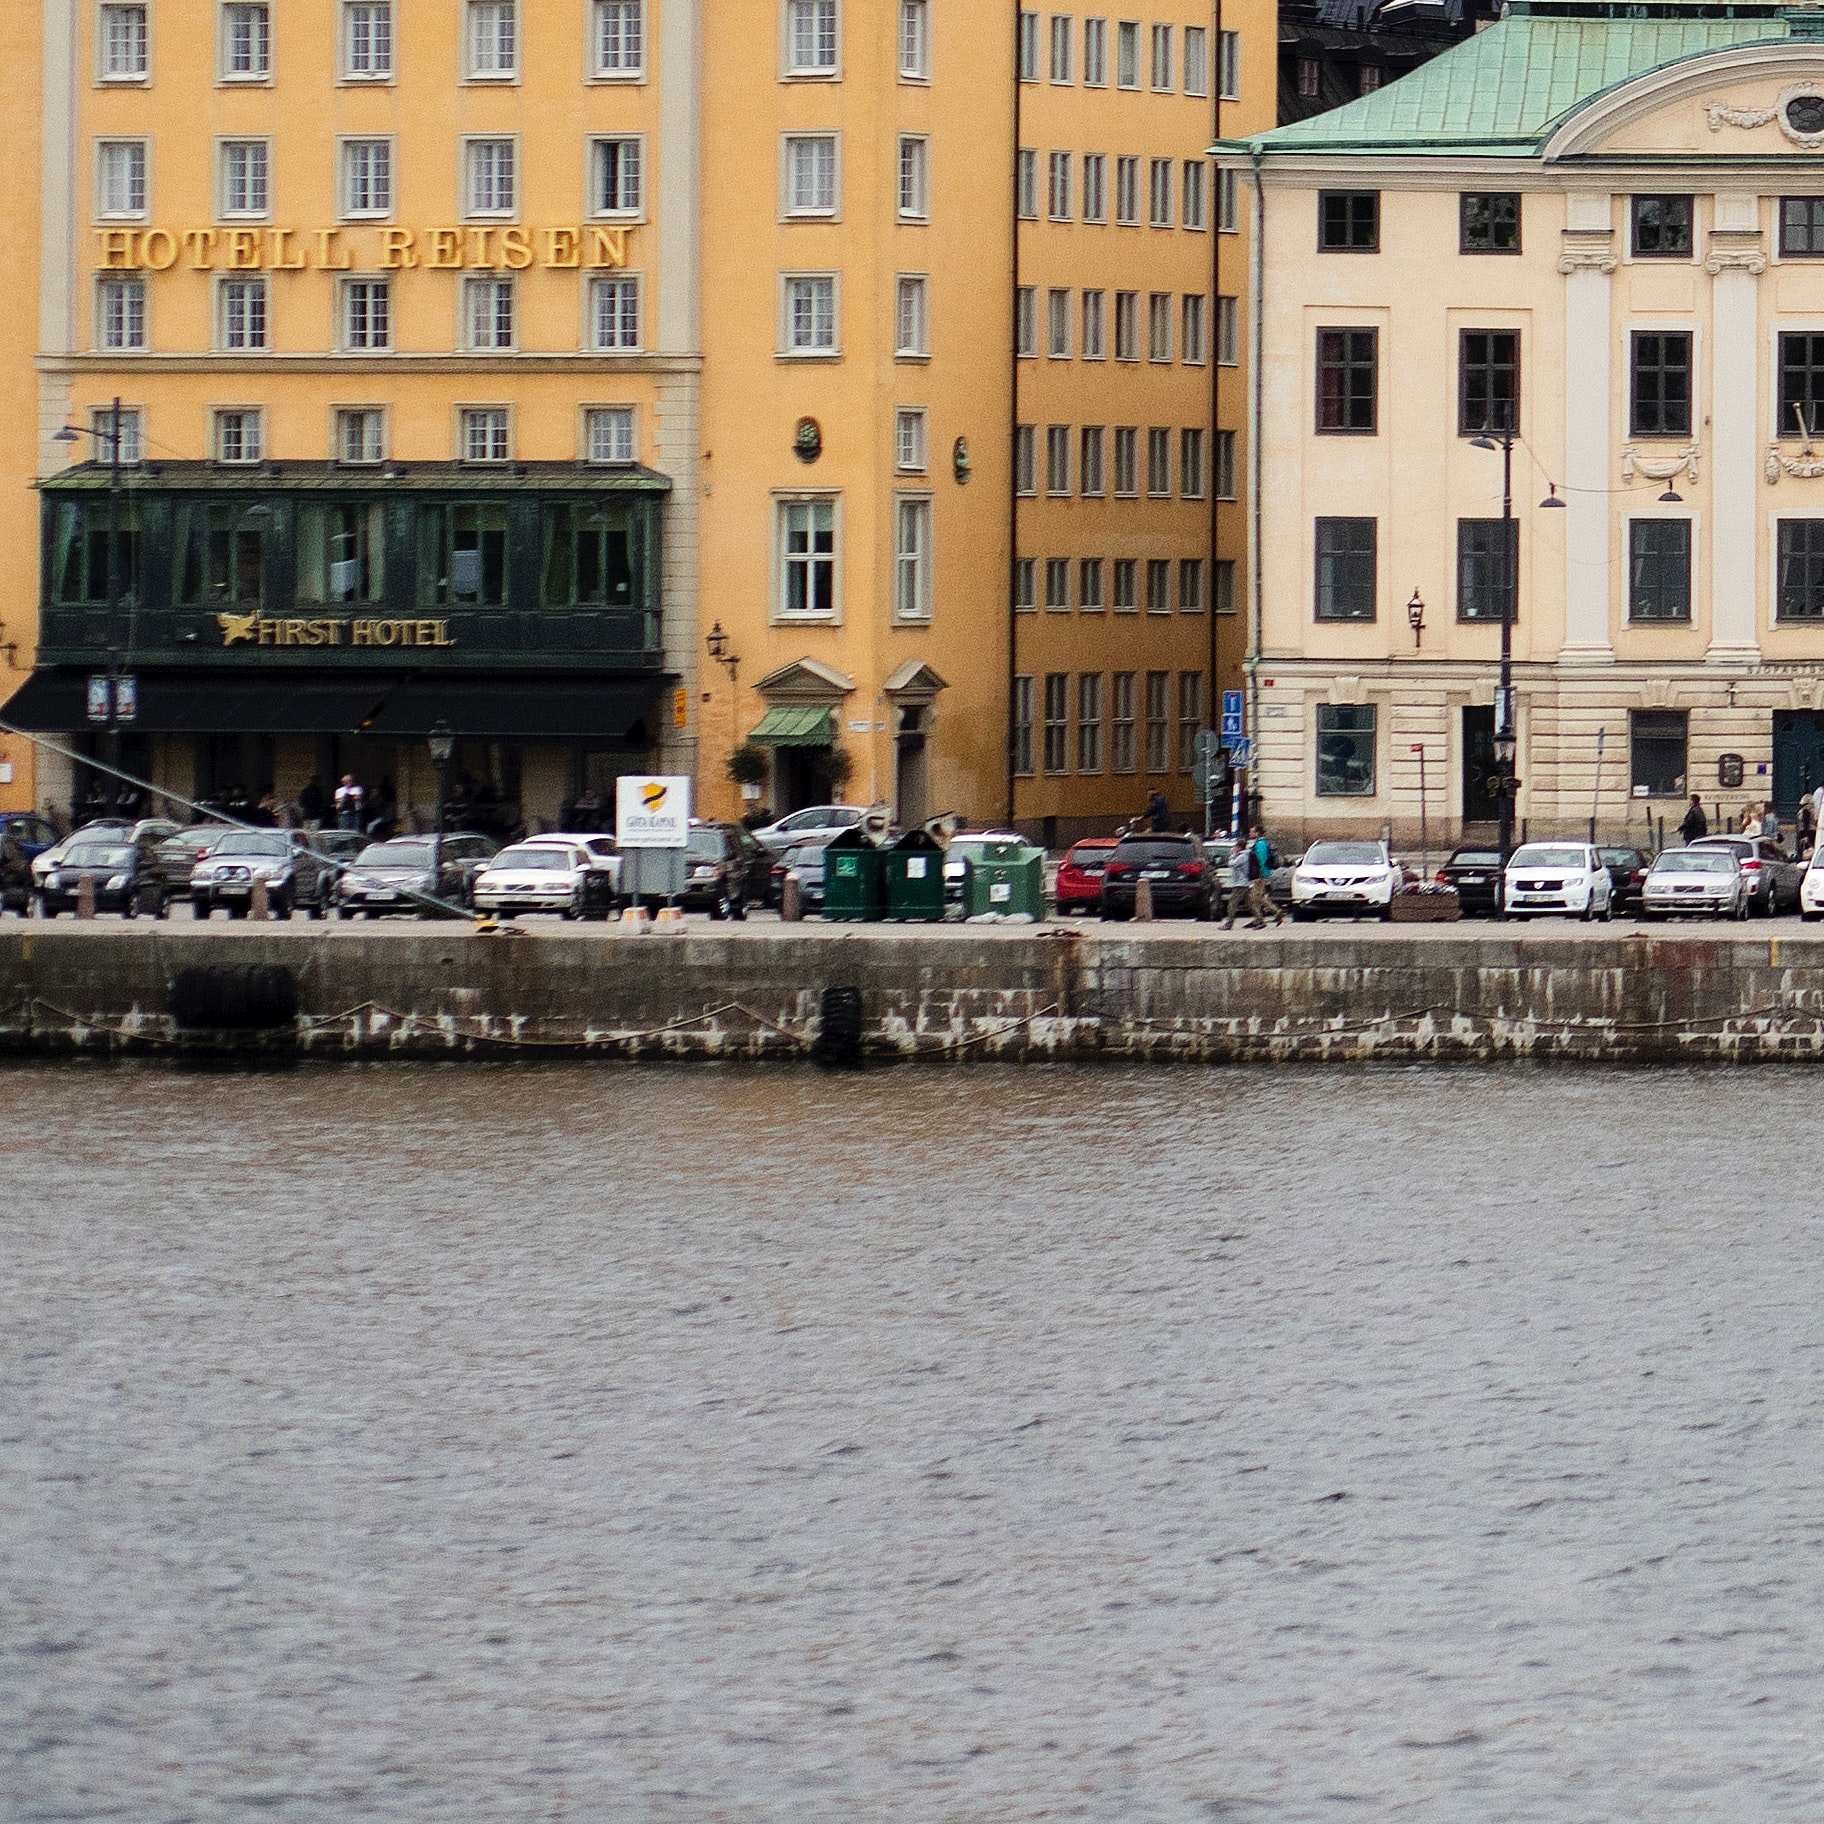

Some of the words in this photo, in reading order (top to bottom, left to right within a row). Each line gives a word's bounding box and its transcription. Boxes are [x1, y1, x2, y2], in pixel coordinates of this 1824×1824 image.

[95, 228, 353, 271] HOTELL
[376, 226, 637, 270] REISEN
[257, 619, 348, 646] FIRST
[351, 619, 455, 646] HOTEL
